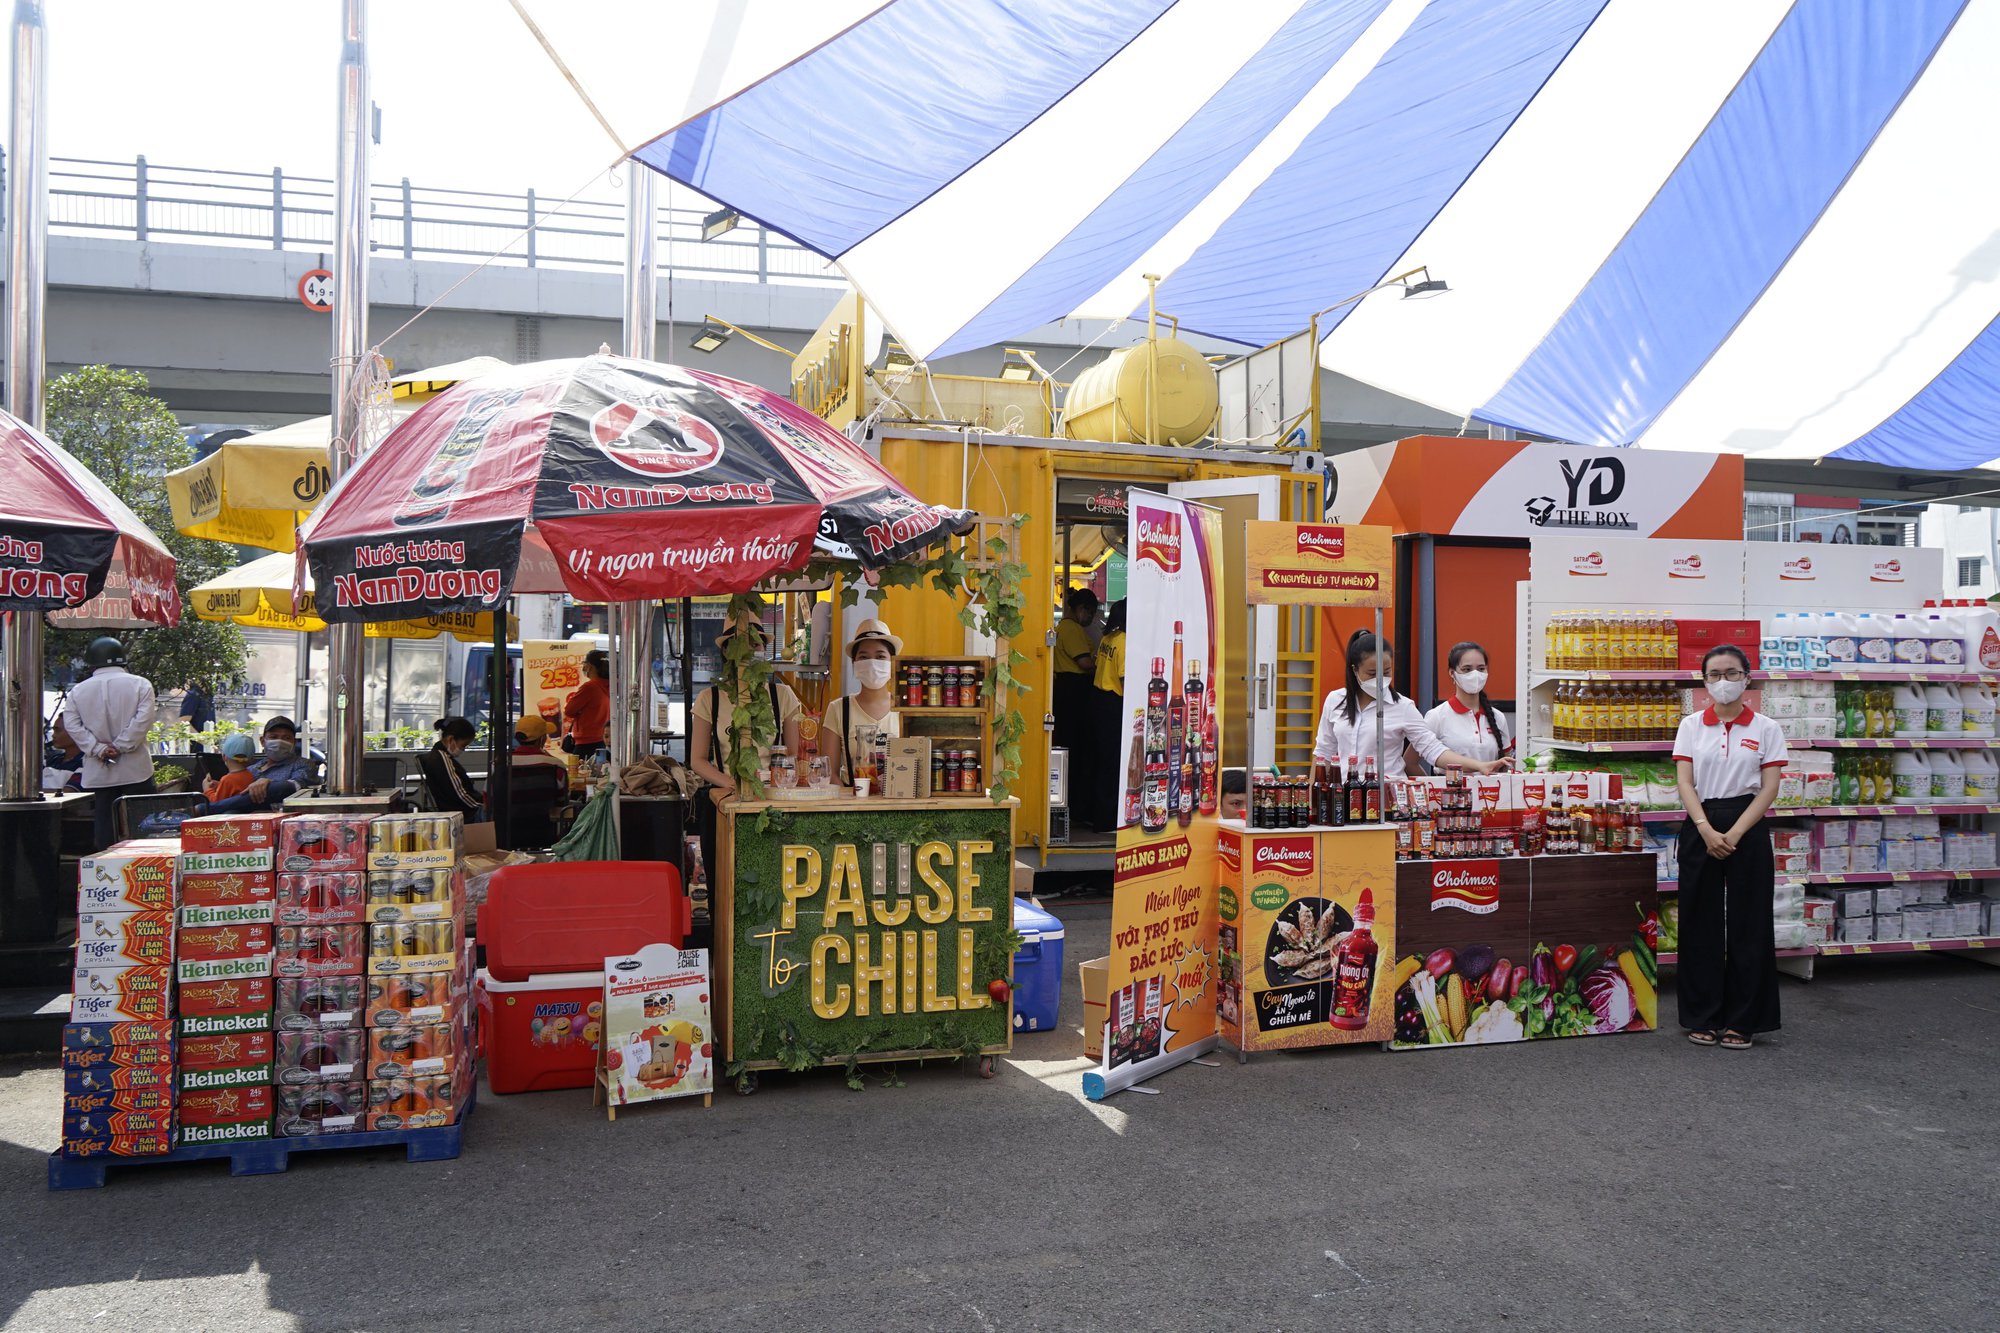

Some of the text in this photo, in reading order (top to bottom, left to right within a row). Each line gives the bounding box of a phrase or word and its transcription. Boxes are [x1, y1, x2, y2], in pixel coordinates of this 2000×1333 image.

[308, 282, 325, 297] 4,9
[637, 455, 697, 466] SINCE 1951
[293, 461, 331, 503] ÔN
[1559, 456, 1626, 509] YD
[568, 482, 775, 510] NamDương
[1098, 498, 1120, 506] MERRY
[1556, 510, 1631, 528] THE BOX
[1137, 519, 1181, 548] Cholimex
[1298, 532, 1344, 546] Cholimex
[355, 540, 465, 568] Nước tương
[568, 534, 799, 580] Vị ngon truyền thống
[334, 566, 501, 608] NamDương
[1280, 573, 1311, 585] NGUYÊN
[1313, 576, 1328, 587] LIỆU
[1342, 575, 1364, 586] NHIÊN
[528, 654, 585, 669] HAPPY HOU
[540, 668, 580, 690] 25%
[184, 853, 268, 871] Heineken
[1256, 846, 1312, 861] Cholimex
[137, 866, 158, 874] KHAI
[780, 840, 993, 929] PAUSE
[1434, 870, 1496, 888] Cholimex
[85, 887, 119, 902] Tiger
[1144, 890, 1171, 914] Món
[1173, 884, 1202, 912] Ngon
[186, 906, 271, 923] Heineken
[83, 941, 117, 957] Tiger
[678, 950, 700, 960] PAUSE
[181, 961, 267, 978] Heineken
[681, 959, 699, 968] CHILL
[753, 928, 992, 1020] To CHILL
[78, 997, 112, 1012] Tiger
[534, 1003, 581, 1018] MATSU
[183, 1015, 268, 1033] Heineken
[1299, 1010, 1312, 1022] MÊ
[67, 1049, 105, 1067] Tiger
[183, 1066, 269, 1088] Heineken
[68, 1095, 105, 1111] Tiger
[183, 1122, 269, 1142] Heineken
[67, 1139, 105, 1156] Tiger
